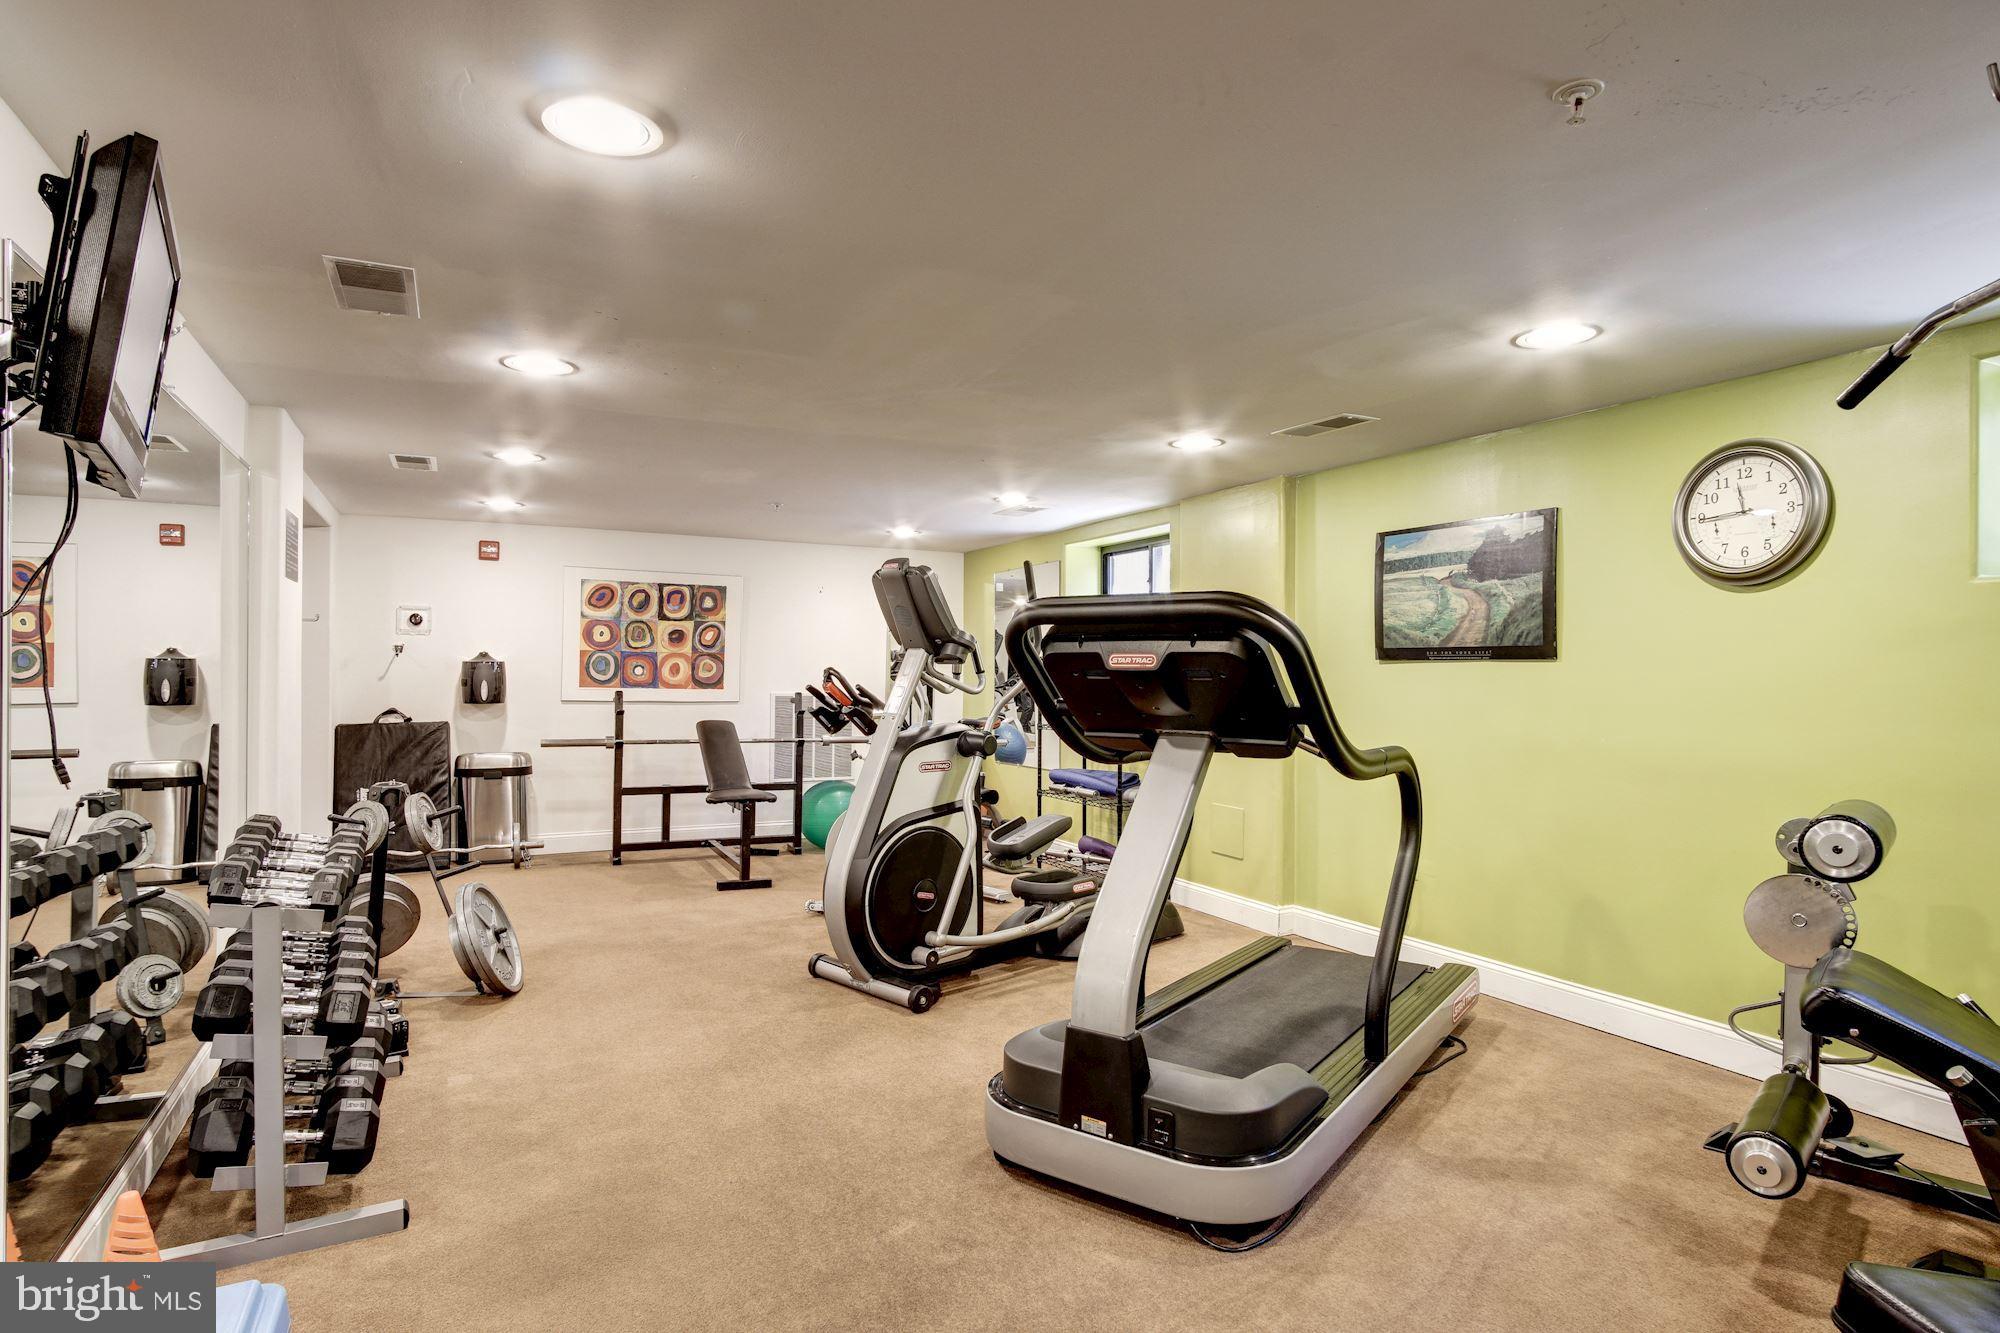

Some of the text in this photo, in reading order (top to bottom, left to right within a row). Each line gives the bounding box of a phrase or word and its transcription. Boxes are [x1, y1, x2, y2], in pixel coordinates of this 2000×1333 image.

[1736, 467, 1753, 480] 12
[1765, 470, 1773, 483] 1
[1715, 477, 1730, 490] 11
[1778, 482, 1788, 495] 2
[1703, 492, 1719, 506] 10
[1786, 500, 1796, 513] 3
[1697, 512, 1706, 525] 9
[1721, 543, 1729, 555] 7
[1763, 538, 1772, 551] 5
[1740, 545, 1749, 558] 6
